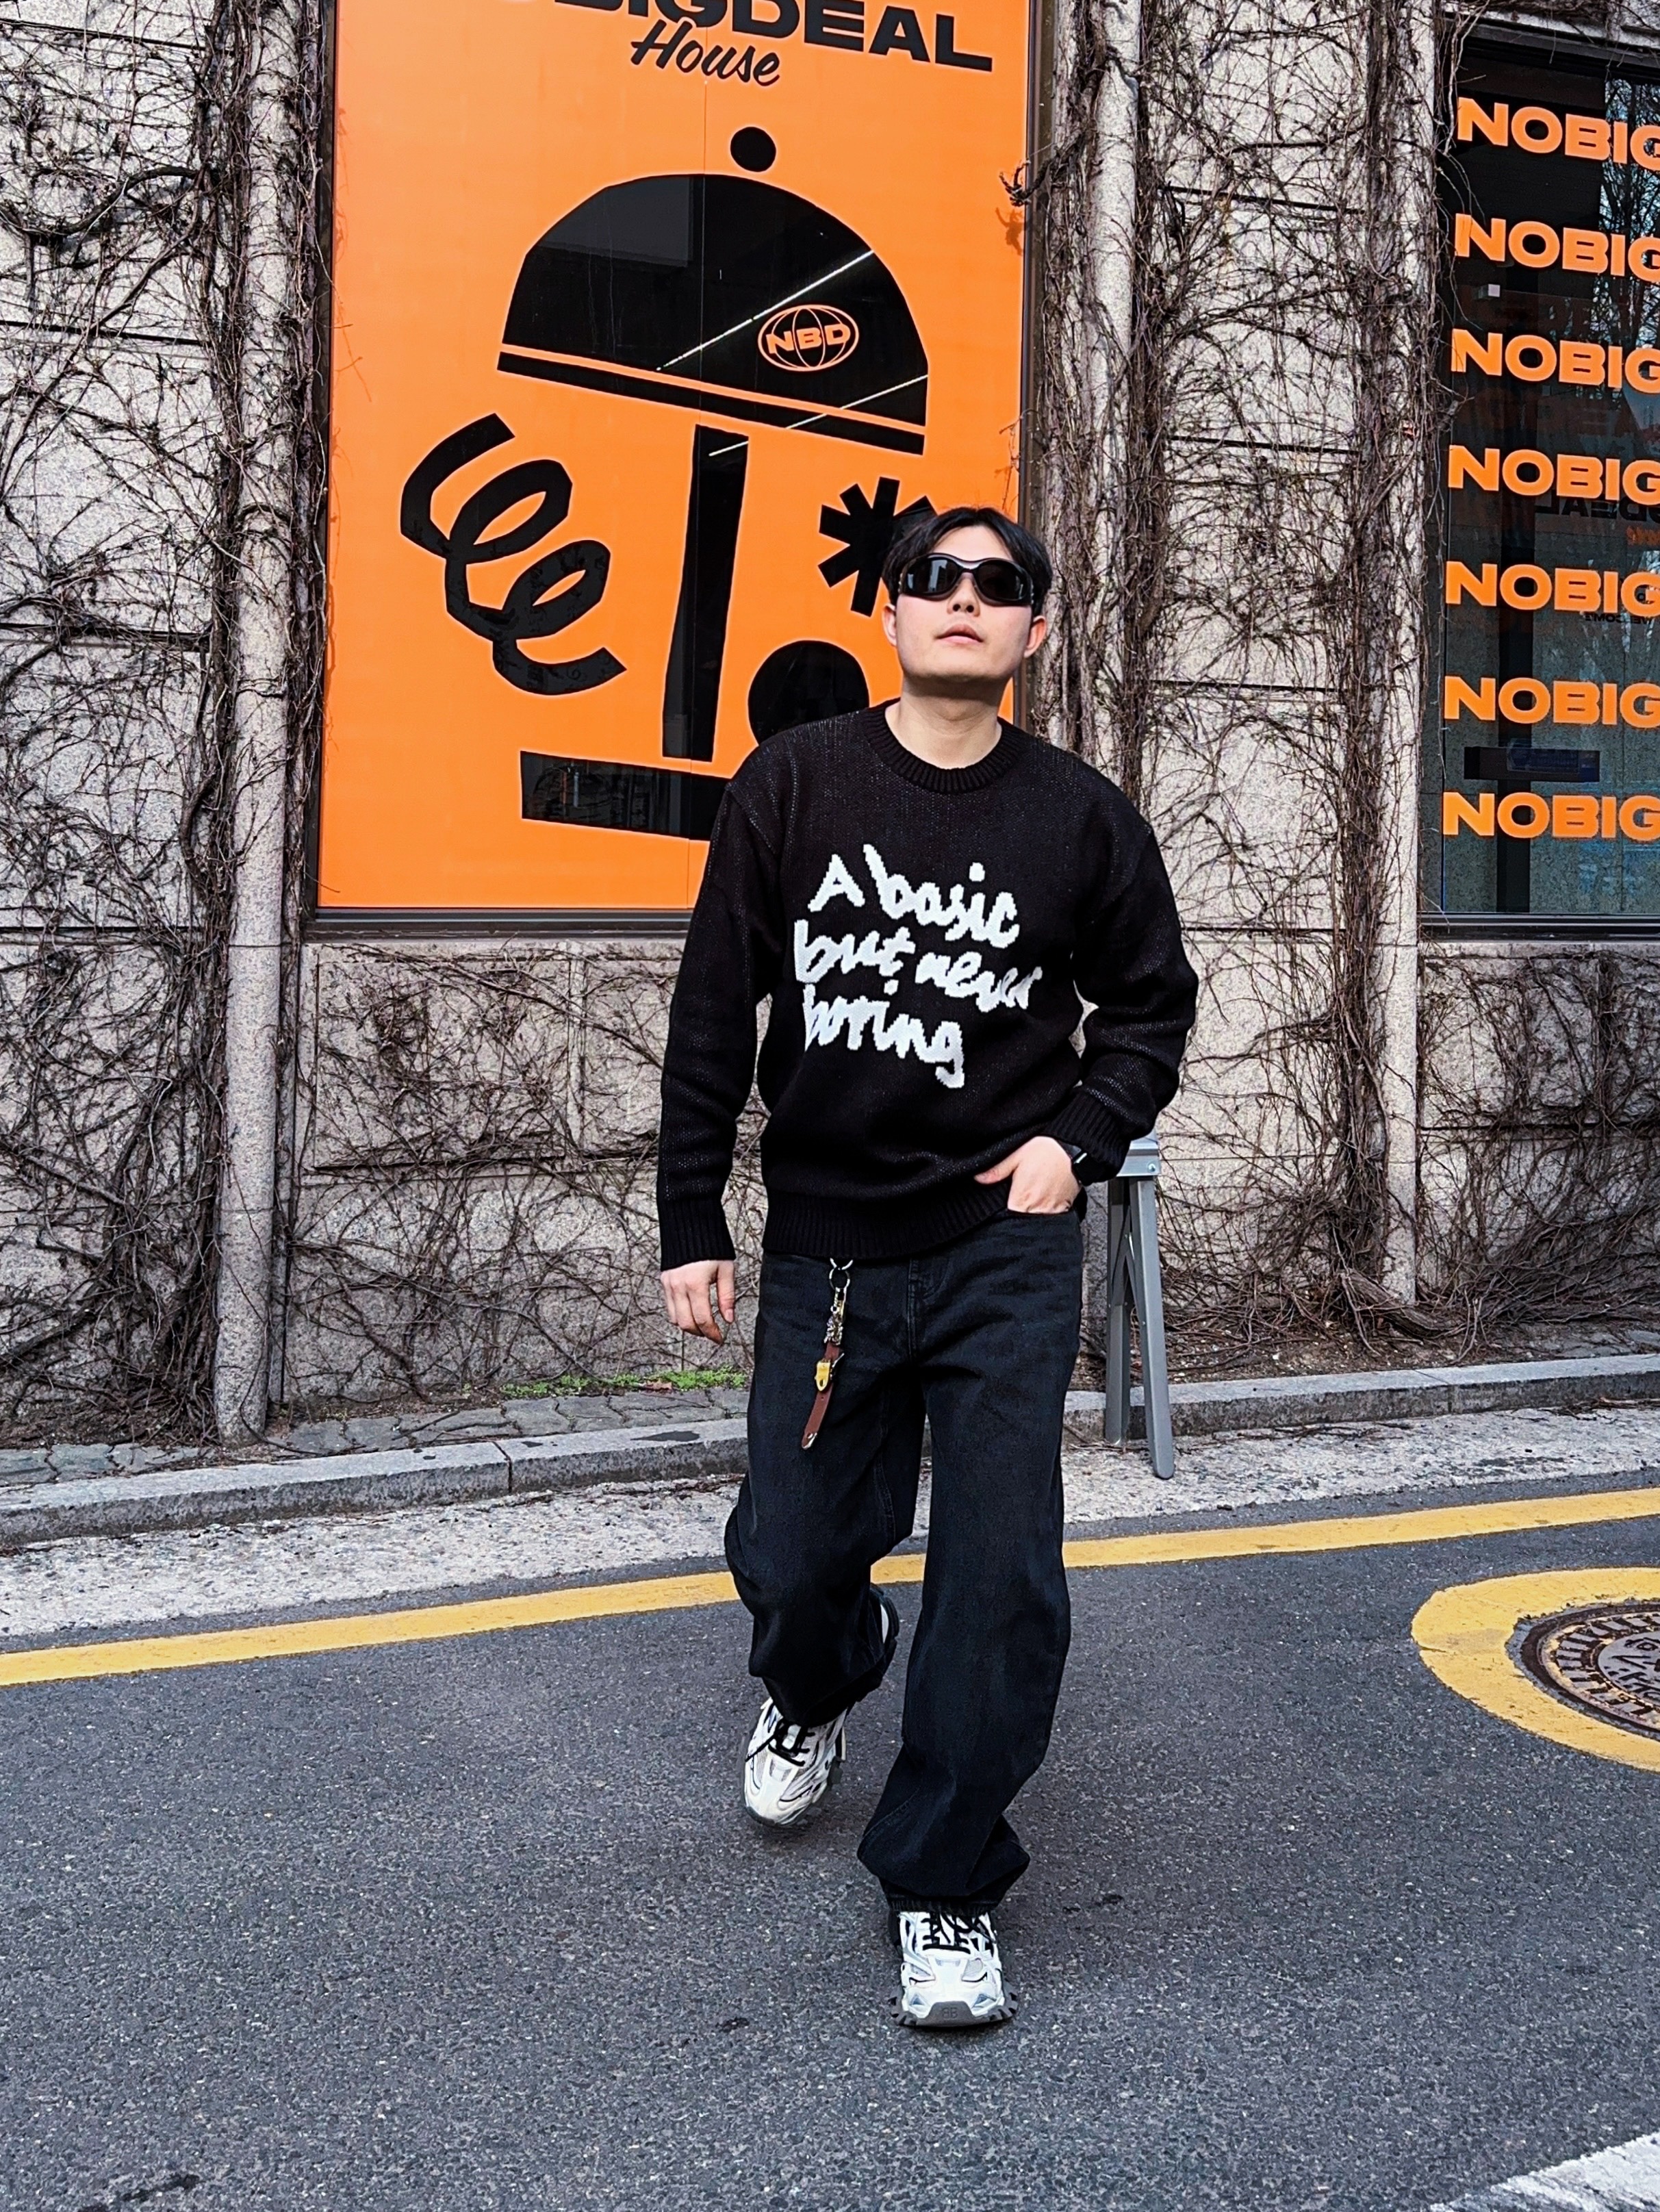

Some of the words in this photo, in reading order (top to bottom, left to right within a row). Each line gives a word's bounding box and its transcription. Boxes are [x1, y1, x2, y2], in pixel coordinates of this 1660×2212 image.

[631, 20, 780, 86] House
[766, 323, 850, 354] NBD
[1448, 446, 1660, 505] NOBIG
[1446, 561, 1660, 617] NOBIG
[1444, 676, 1660, 728] NOBIG
[1444, 792, 1660, 841] NOBIG
[808, 854, 865, 912] A
[863, 844, 1019, 948] basic
[794, 919, 915, 982] but
[915, 952, 1042, 1012] never
[802, 980, 965, 1088] boring
